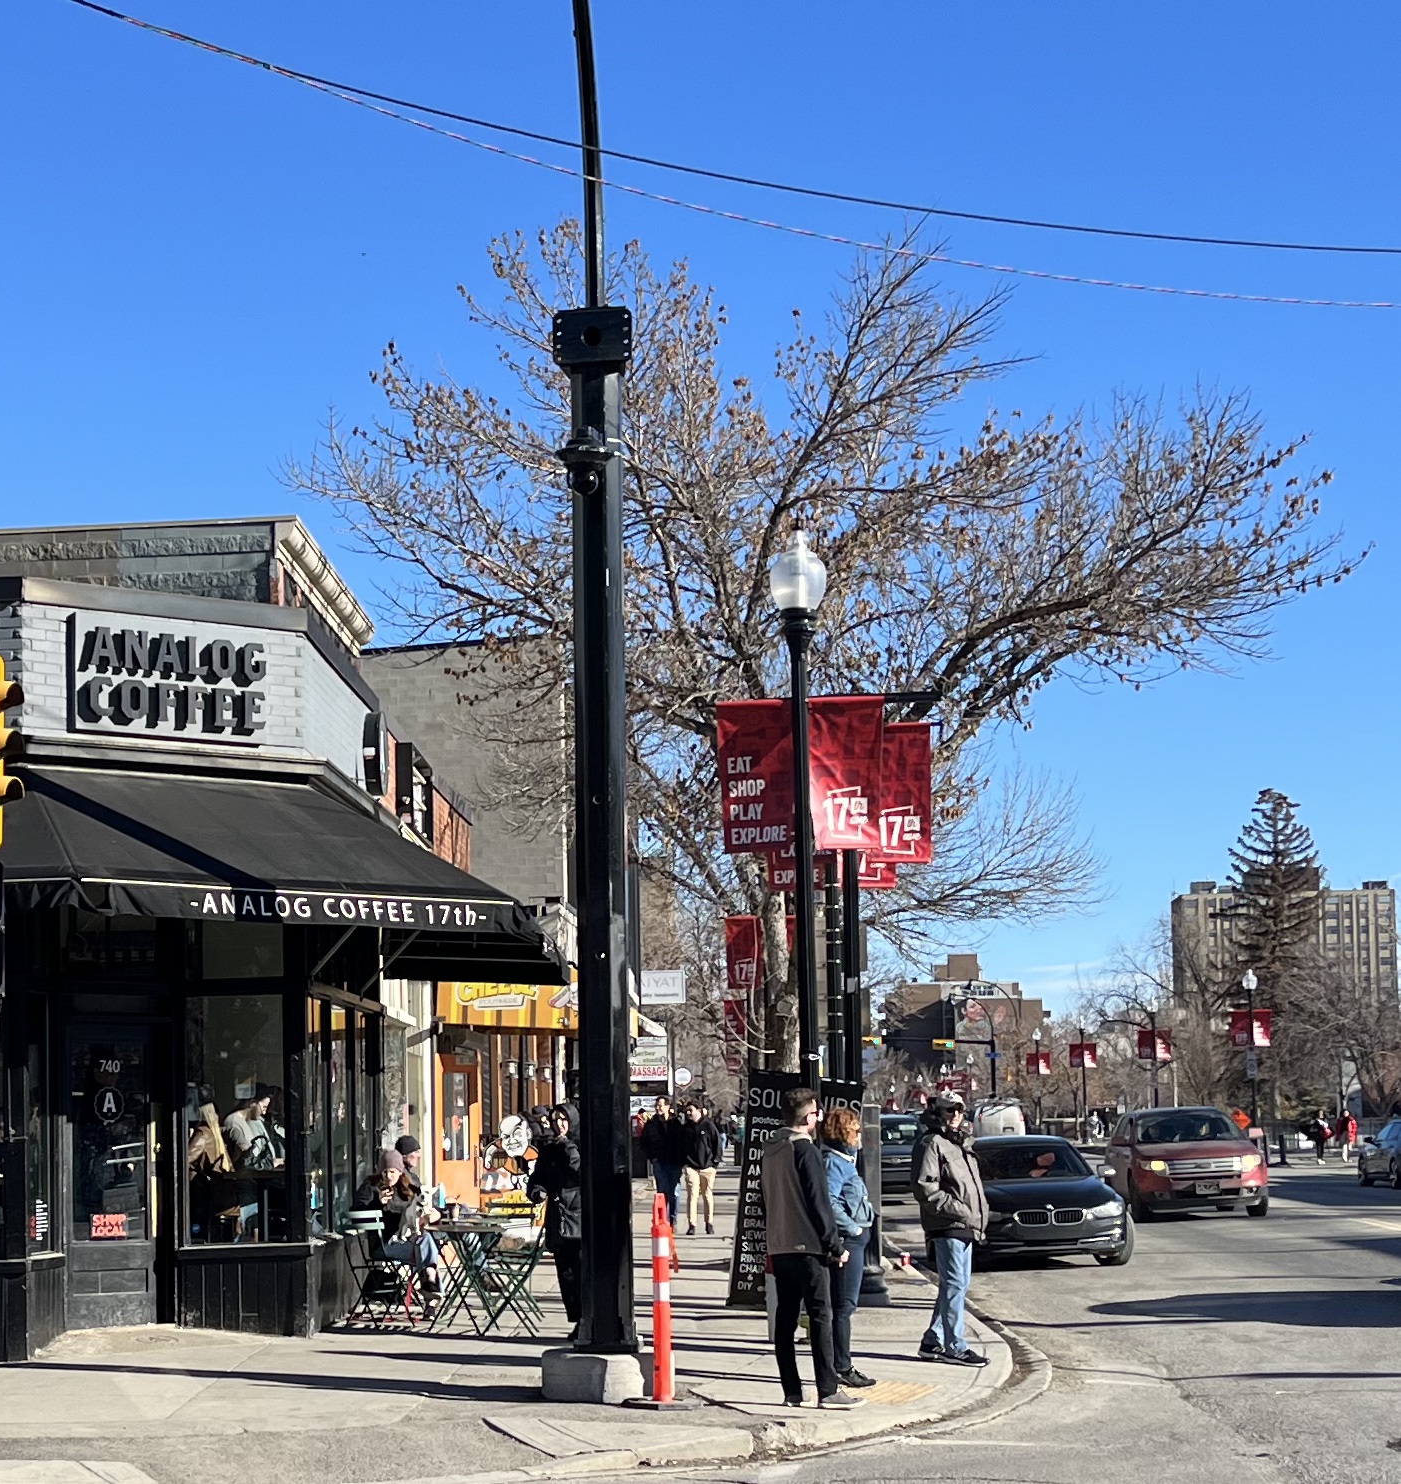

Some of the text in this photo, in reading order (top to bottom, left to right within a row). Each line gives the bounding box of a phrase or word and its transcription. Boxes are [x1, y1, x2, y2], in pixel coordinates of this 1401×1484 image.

[83, 626, 266, 683] ANALOG
[82, 676, 267, 733] COFFEE
[727, 756, 752, 774] EAT
[728, 779, 765, 798] SHOP
[729, 804, 763, 821] PLAY
[731, 825, 788, 845] EXPLORE
[322, 897, 415, 923] COFFEE
[99, 1060, 121, 1073] 740
[102, 1092, 117, 1113] A
[737, 1281, 753, 1291] DIY
